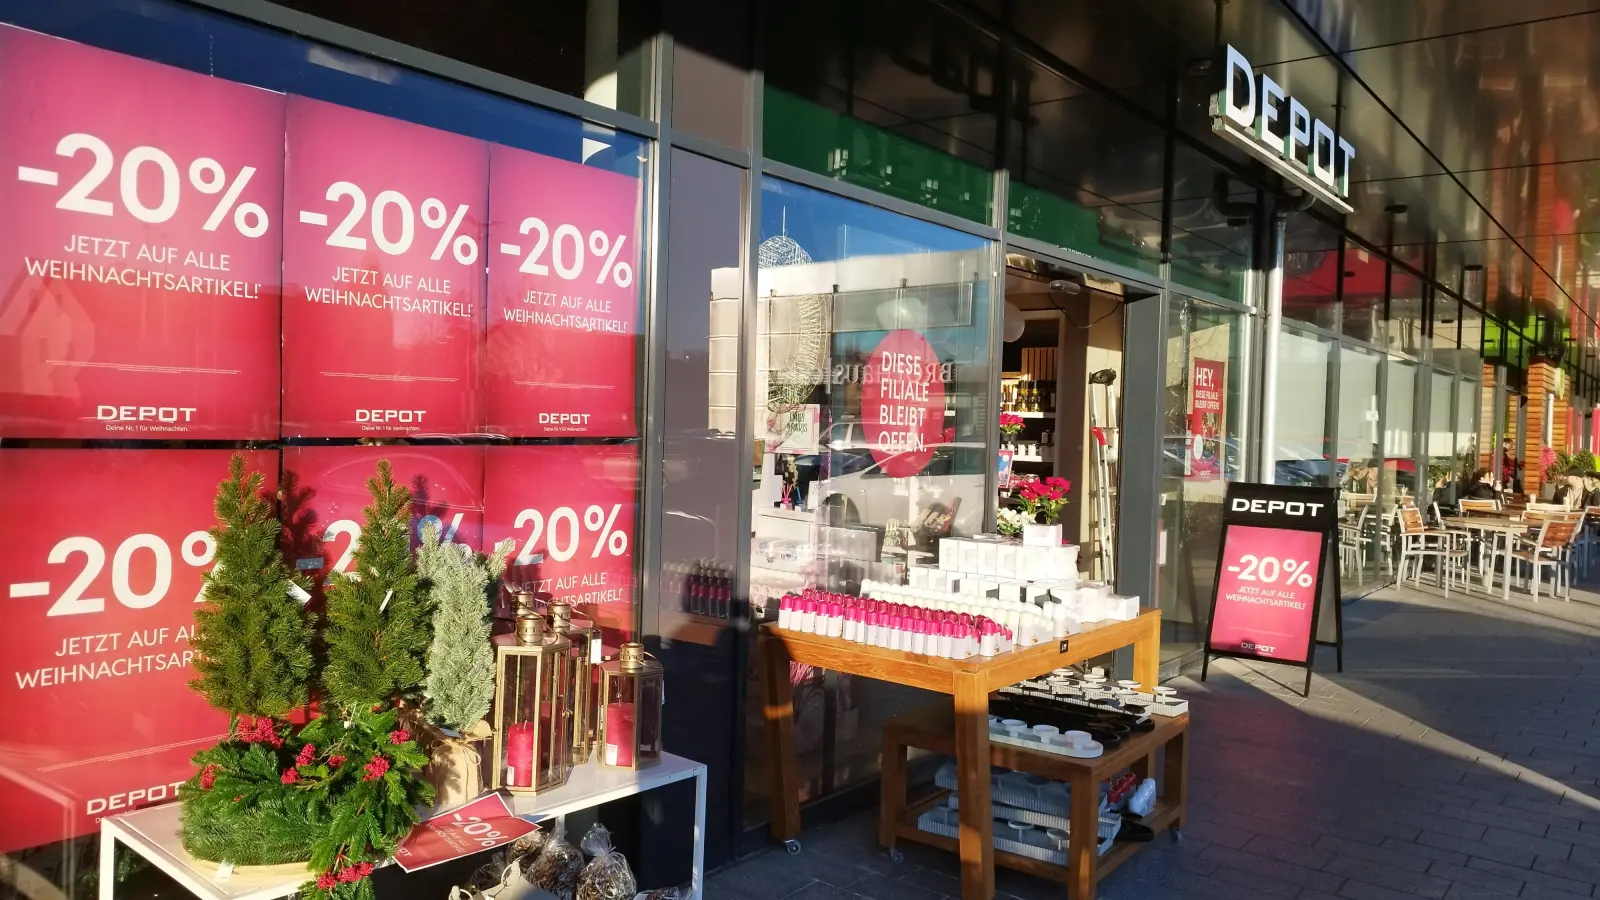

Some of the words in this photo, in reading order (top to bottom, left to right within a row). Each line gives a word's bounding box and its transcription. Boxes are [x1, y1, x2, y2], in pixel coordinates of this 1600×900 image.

[1226, 43, 1356, 198] DEPOT
[18, 133, 269, 238] -20%
[299, 181, 478, 266] -20%
[64, 234, 130, 259] JETZT
[136, 244, 178, 264] AUF
[183, 250, 231, 271] ALLE
[500, 217, 633, 289] -20%
[332, 266, 379, 286] JETZT
[382, 272, 413, 290] AUF
[416, 277, 451, 295] ALLE
[523, 289, 556, 307] JETZT
[560, 294, 584, 310] AUF
[586, 298, 612, 314] ALLE
[881, 351, 921, 376] DIESE
[880, 377, 930, 402] FILIALE
[1195, 366, 1214, 390] HEY,
[97, 405, 197, 422] DEPOT
[355, 409, 427, 423] DEPOT
[538, 413, 591, 425] DEPOT
[879, 404, 926, 427] BLEIBT
[878, 430, 927, 453] OFFEN.
[1231, 497, 1325, 517] DEPOT
[555, 575, 578, 590] AUF
[580, 572, 607, 587] ALLE
[1227, 554, 1313, 588] -20%
[1237, 586, 1259, 595] JETZT
[1260, 588, 1276, 597] AUF
[1276, 591, 1296, 599] ALLE
[55, 632, 121, 657] JETZT
[127, 627, 170, 650] AUF
[175, 624, 200, 643] AL
[1240, 642, 1276, 653] DEPOT
[86, 781, 187, 815] DEPOT
